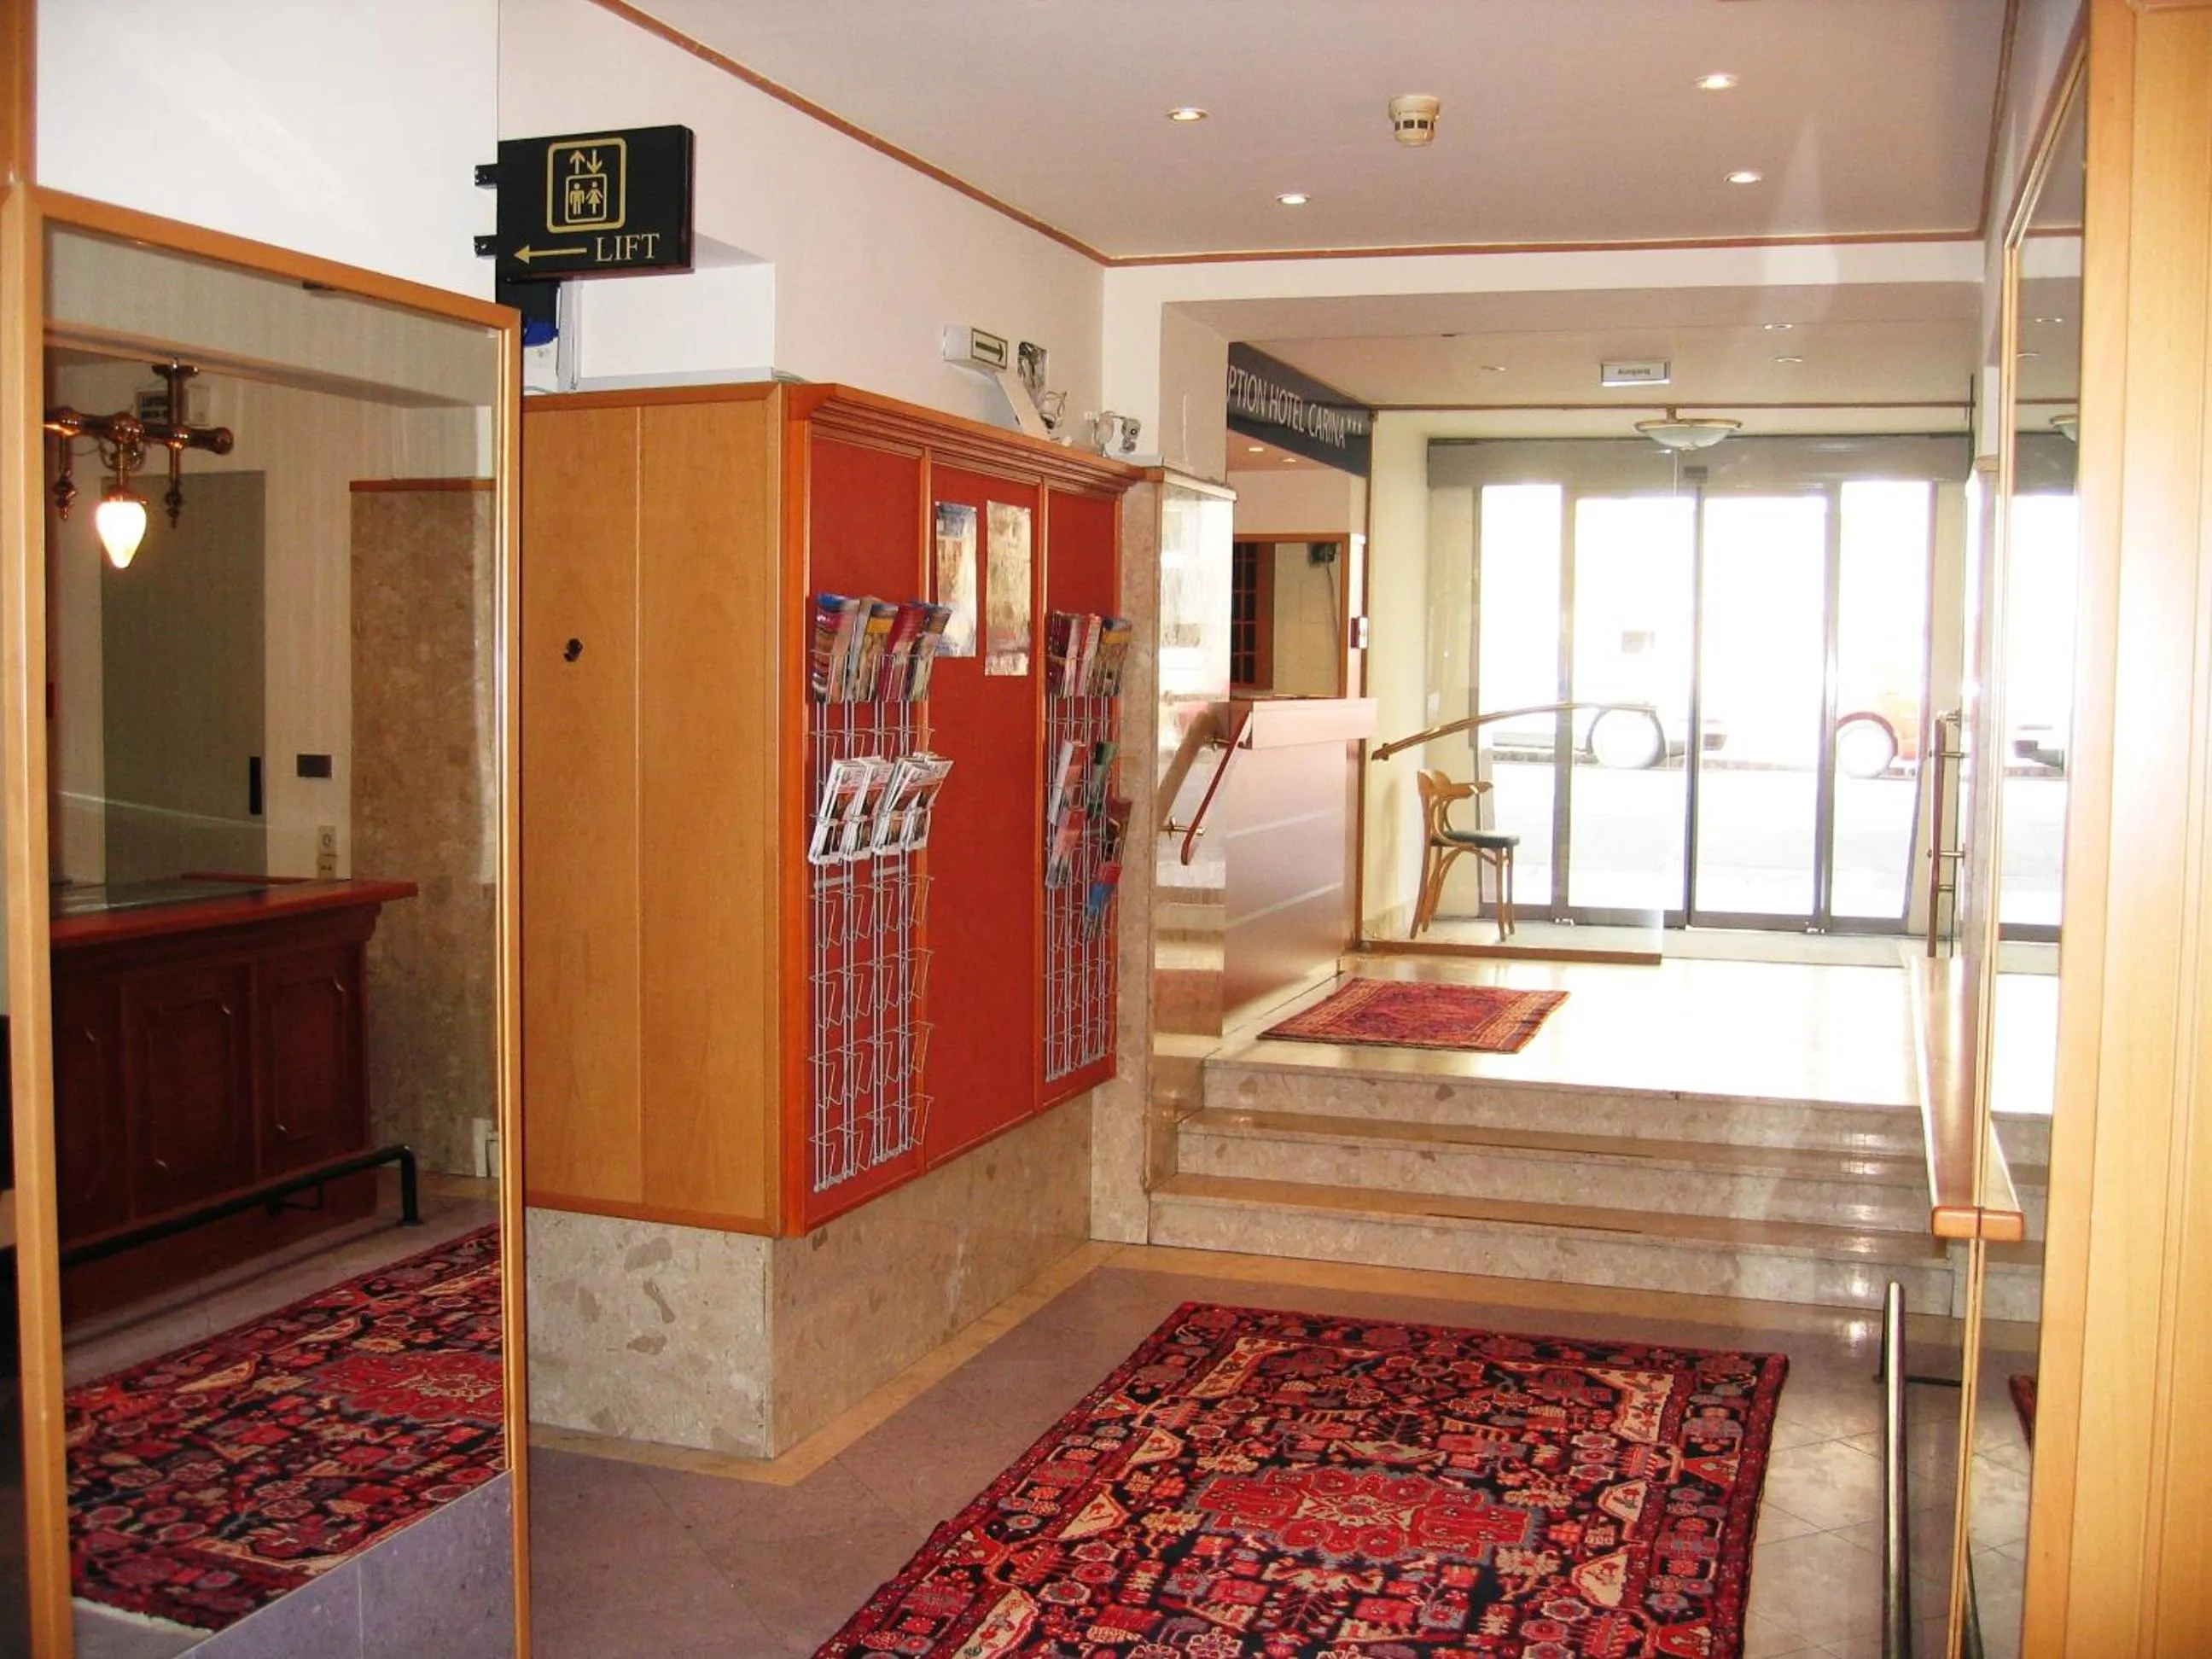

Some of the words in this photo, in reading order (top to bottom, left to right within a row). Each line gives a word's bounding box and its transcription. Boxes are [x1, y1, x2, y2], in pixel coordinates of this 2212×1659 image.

[595, 233, 660, 262] LIFT
[1226, 365, 1268, 416] PTION
[1269, 383, 1305, 433] HOTEL
[1308, 403, 1346, 449] CARINA
